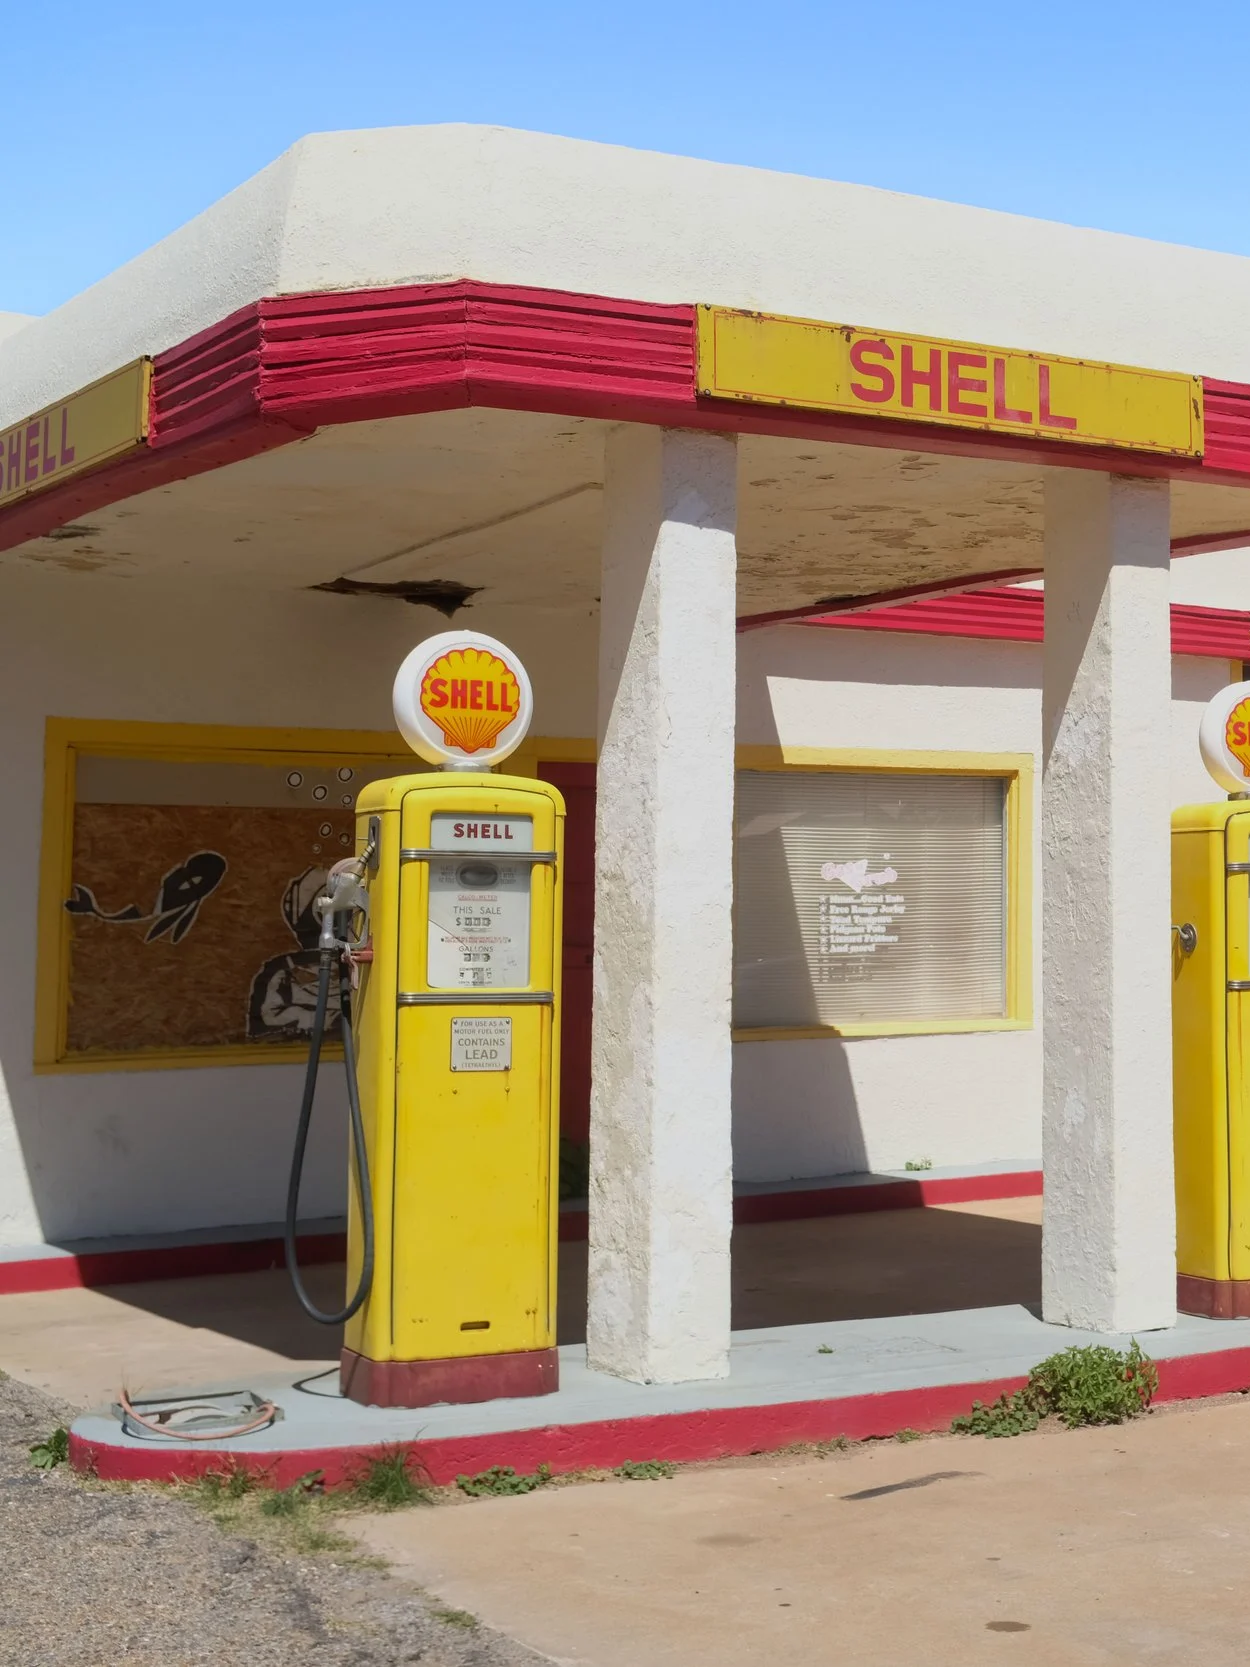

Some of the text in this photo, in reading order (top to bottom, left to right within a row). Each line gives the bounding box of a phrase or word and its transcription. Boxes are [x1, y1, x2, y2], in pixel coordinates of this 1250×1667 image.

[850, 339, 1077, 430] SHELL
[429, 678, 512, 713] SHELL
[453, 823, 514, 840] SHELL
[453, 906, 502, 915] THIS SALE
[829, 905, 849, 914] Free
[458, 945, 494, 953] GALLONS
[458, 1038, 505, 1046] CONTAINS
[465, 1049, 498, 1060] LEAD
